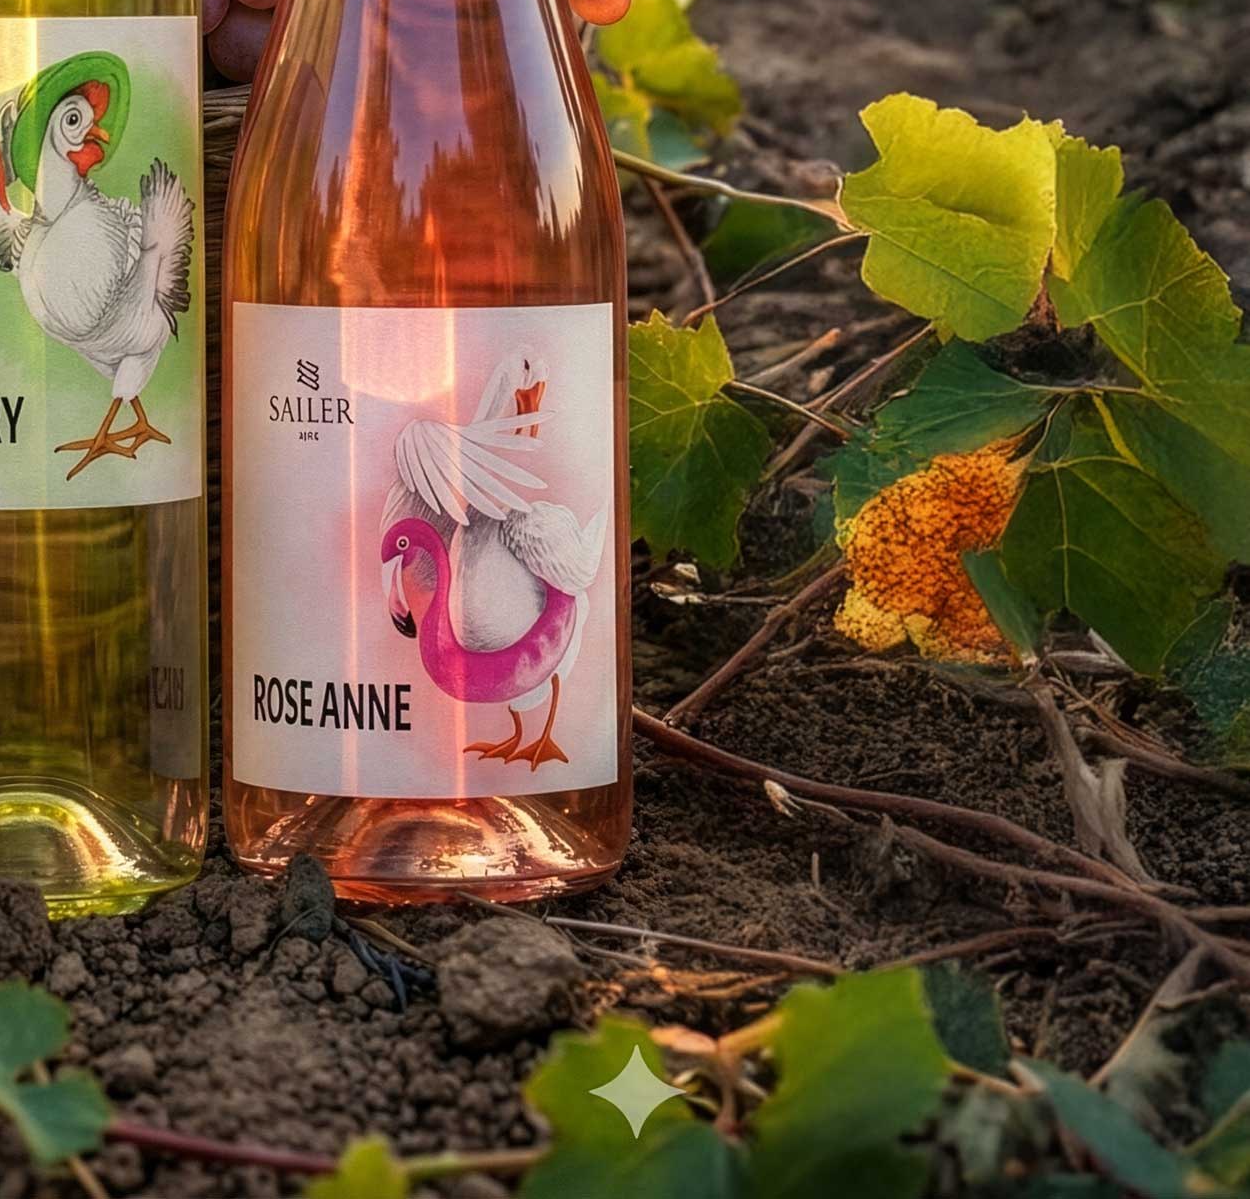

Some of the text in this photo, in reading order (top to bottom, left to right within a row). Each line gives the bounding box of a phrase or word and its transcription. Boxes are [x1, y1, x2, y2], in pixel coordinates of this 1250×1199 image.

[269, 396, 354, 425] SAILER
[253, 674, 412, 731] ROSE ANNE
